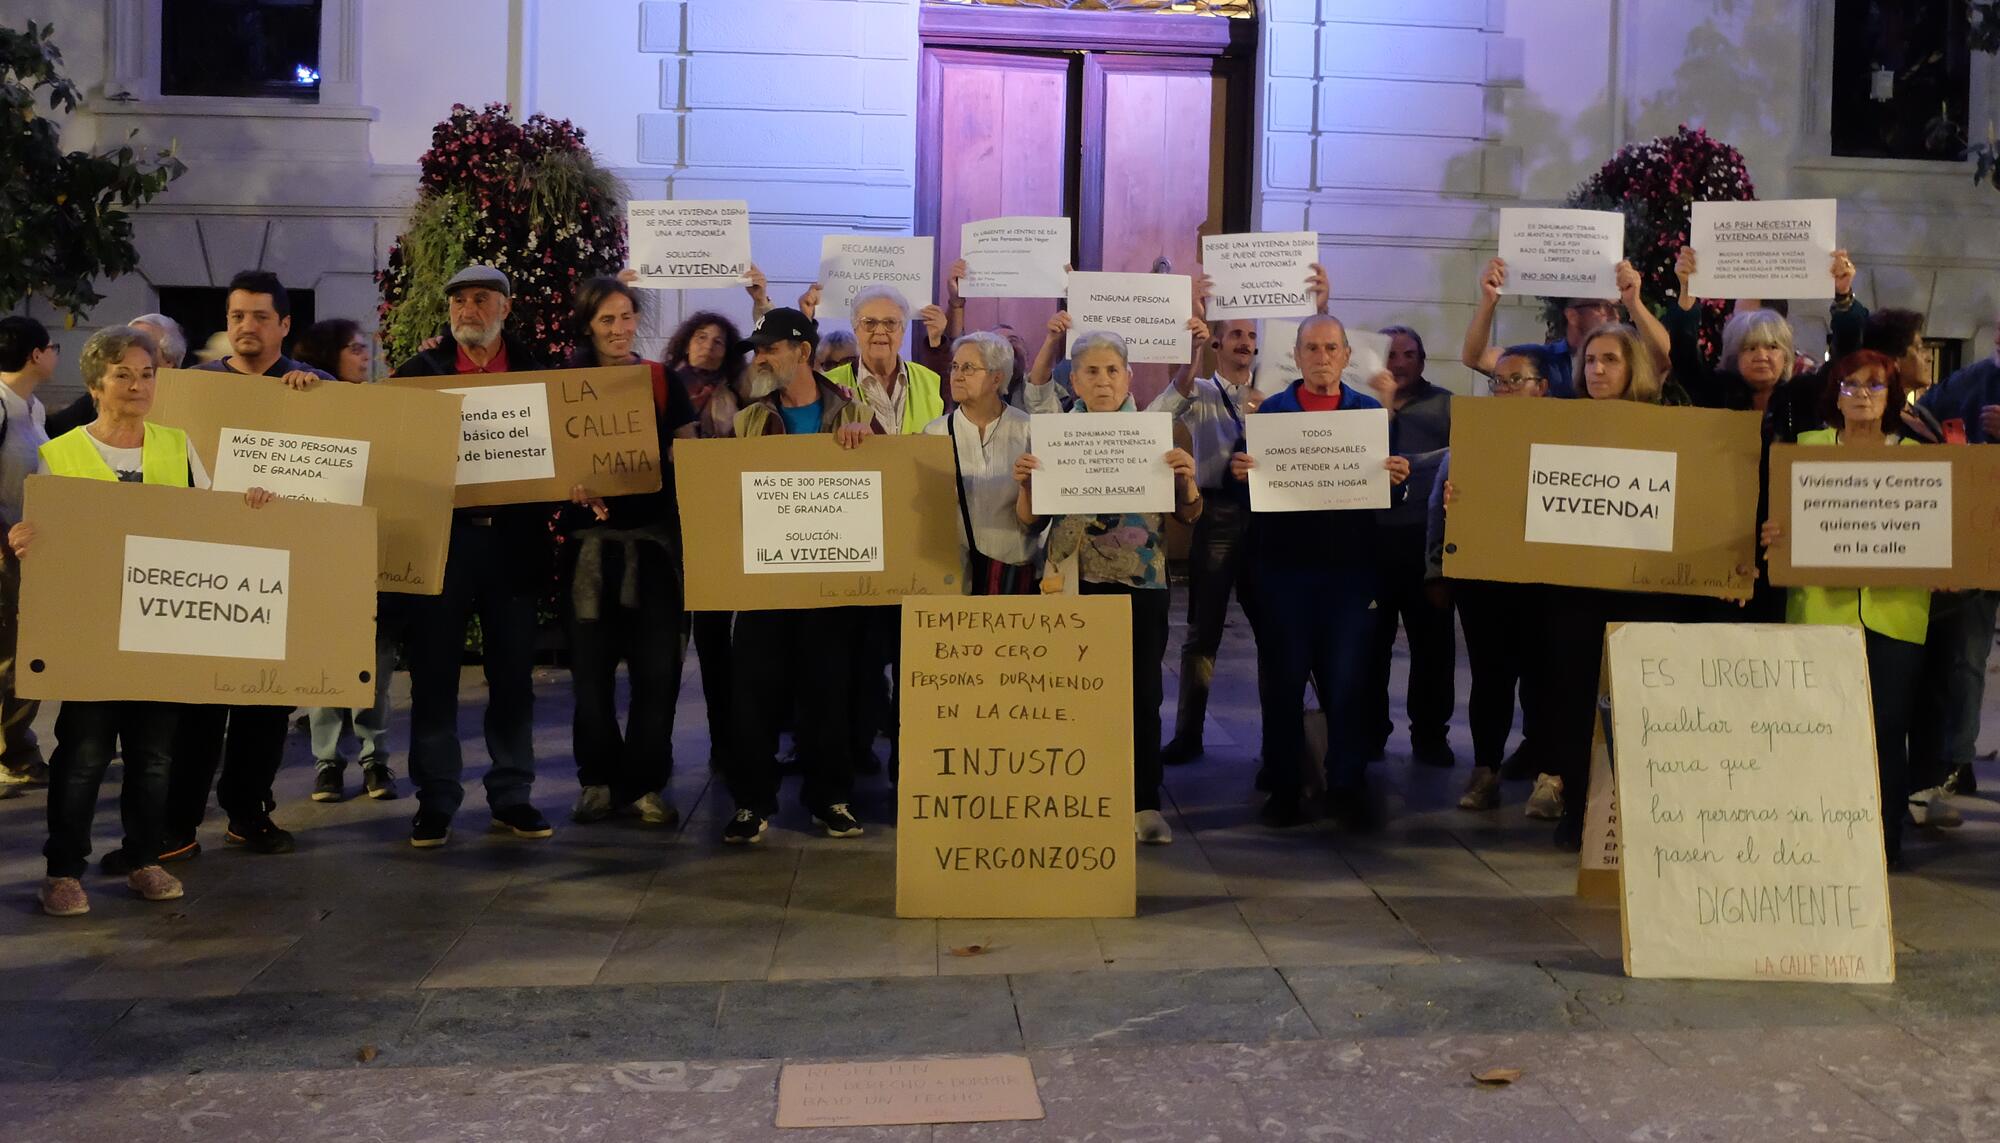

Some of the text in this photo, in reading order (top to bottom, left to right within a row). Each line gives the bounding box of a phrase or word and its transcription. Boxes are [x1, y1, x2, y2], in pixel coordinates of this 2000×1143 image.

[1757, 220, 1811, 229] NECESITAN
[841, 244, 905, 254] RECLAMAMOS
[852, 259, 894, 267] VIVIENDA
[829, 271, 920, 281] PARA LAS PERSONAS
[1217, 296, 1237, 306] ¡¡LA
[562, 380, 598, 403] LA
[502, 407, 530, 418] es el
[464, 427, 528, 441] básico del
[566, 410, 642, 438] CALLE
[232, 434, 357, 455] MÁS DE 300 PERSONAS
[465, 451, 480, 461] de
[485, 448, 546, 460] bienestar
[1300, 446, 1366, 454] RESPONSABLES
[233, 450, 353, 468] VIVEN EN LAS CALLES
[253, 465, 267, 473] DE
[592, 450, 652, 474] MATA
[1291, 463, 1330, 471] ATENDER
[754, 477, 870, 487] MÁS DE 300 PERSONAS
[1532, 470, 1671, 492] ¡DERECHO A LA
[1800, 475, 1942, 488] Viviendas y Centros
[757, 492, 788, 500] VIVEN
[833, 491, 869, 499] CALLES
[1804, 499, 1937, 511] permanentes para
[1542, 496, 1658, 519] VIVIENDA!
[786, 530, 842, 541] SOLUCIÓN:
[1820, 519, 1920, 532] quienes viven
[757, 547, 877, 561] ¡¡LA VIVIENDA!!
[1834, 542, 1906, 553] en la calle
[127, 566, 283, 594] ¡DERECHO A LA
[139, 598, 270, 625] VIVIENDA!
[914, 611, 1086, 632] TEMPERATURAS
[936, 642, 1088, 662] BAJO CERO Y
[214, 669, 344, 694] La calle mata
[912, 671, 1104, 692] PERSONAS DURMIENDO
[1641, 659, 1818, 688] ES URGENTE
[938, 704, 1075, 722] EN LA CALLE.
[1641, 706, 1834, 752] facilitar espacios
[933, 748, 1086, 776] INJUSTO
[1646, 758, 1761, 790] para que
[913, 794, 1111, 820] INTOLERABLE
[1651, 795, 1873, 843] las personas sin hogar
[936, 846, 1116, 871] VERGONZOSO
[1653, 836, 1821, 878] pasen el día
[1698, 885, 1868, 930] DIGNAMENTE
[1754, 955, 1866, 978] LA CALLE MATA
